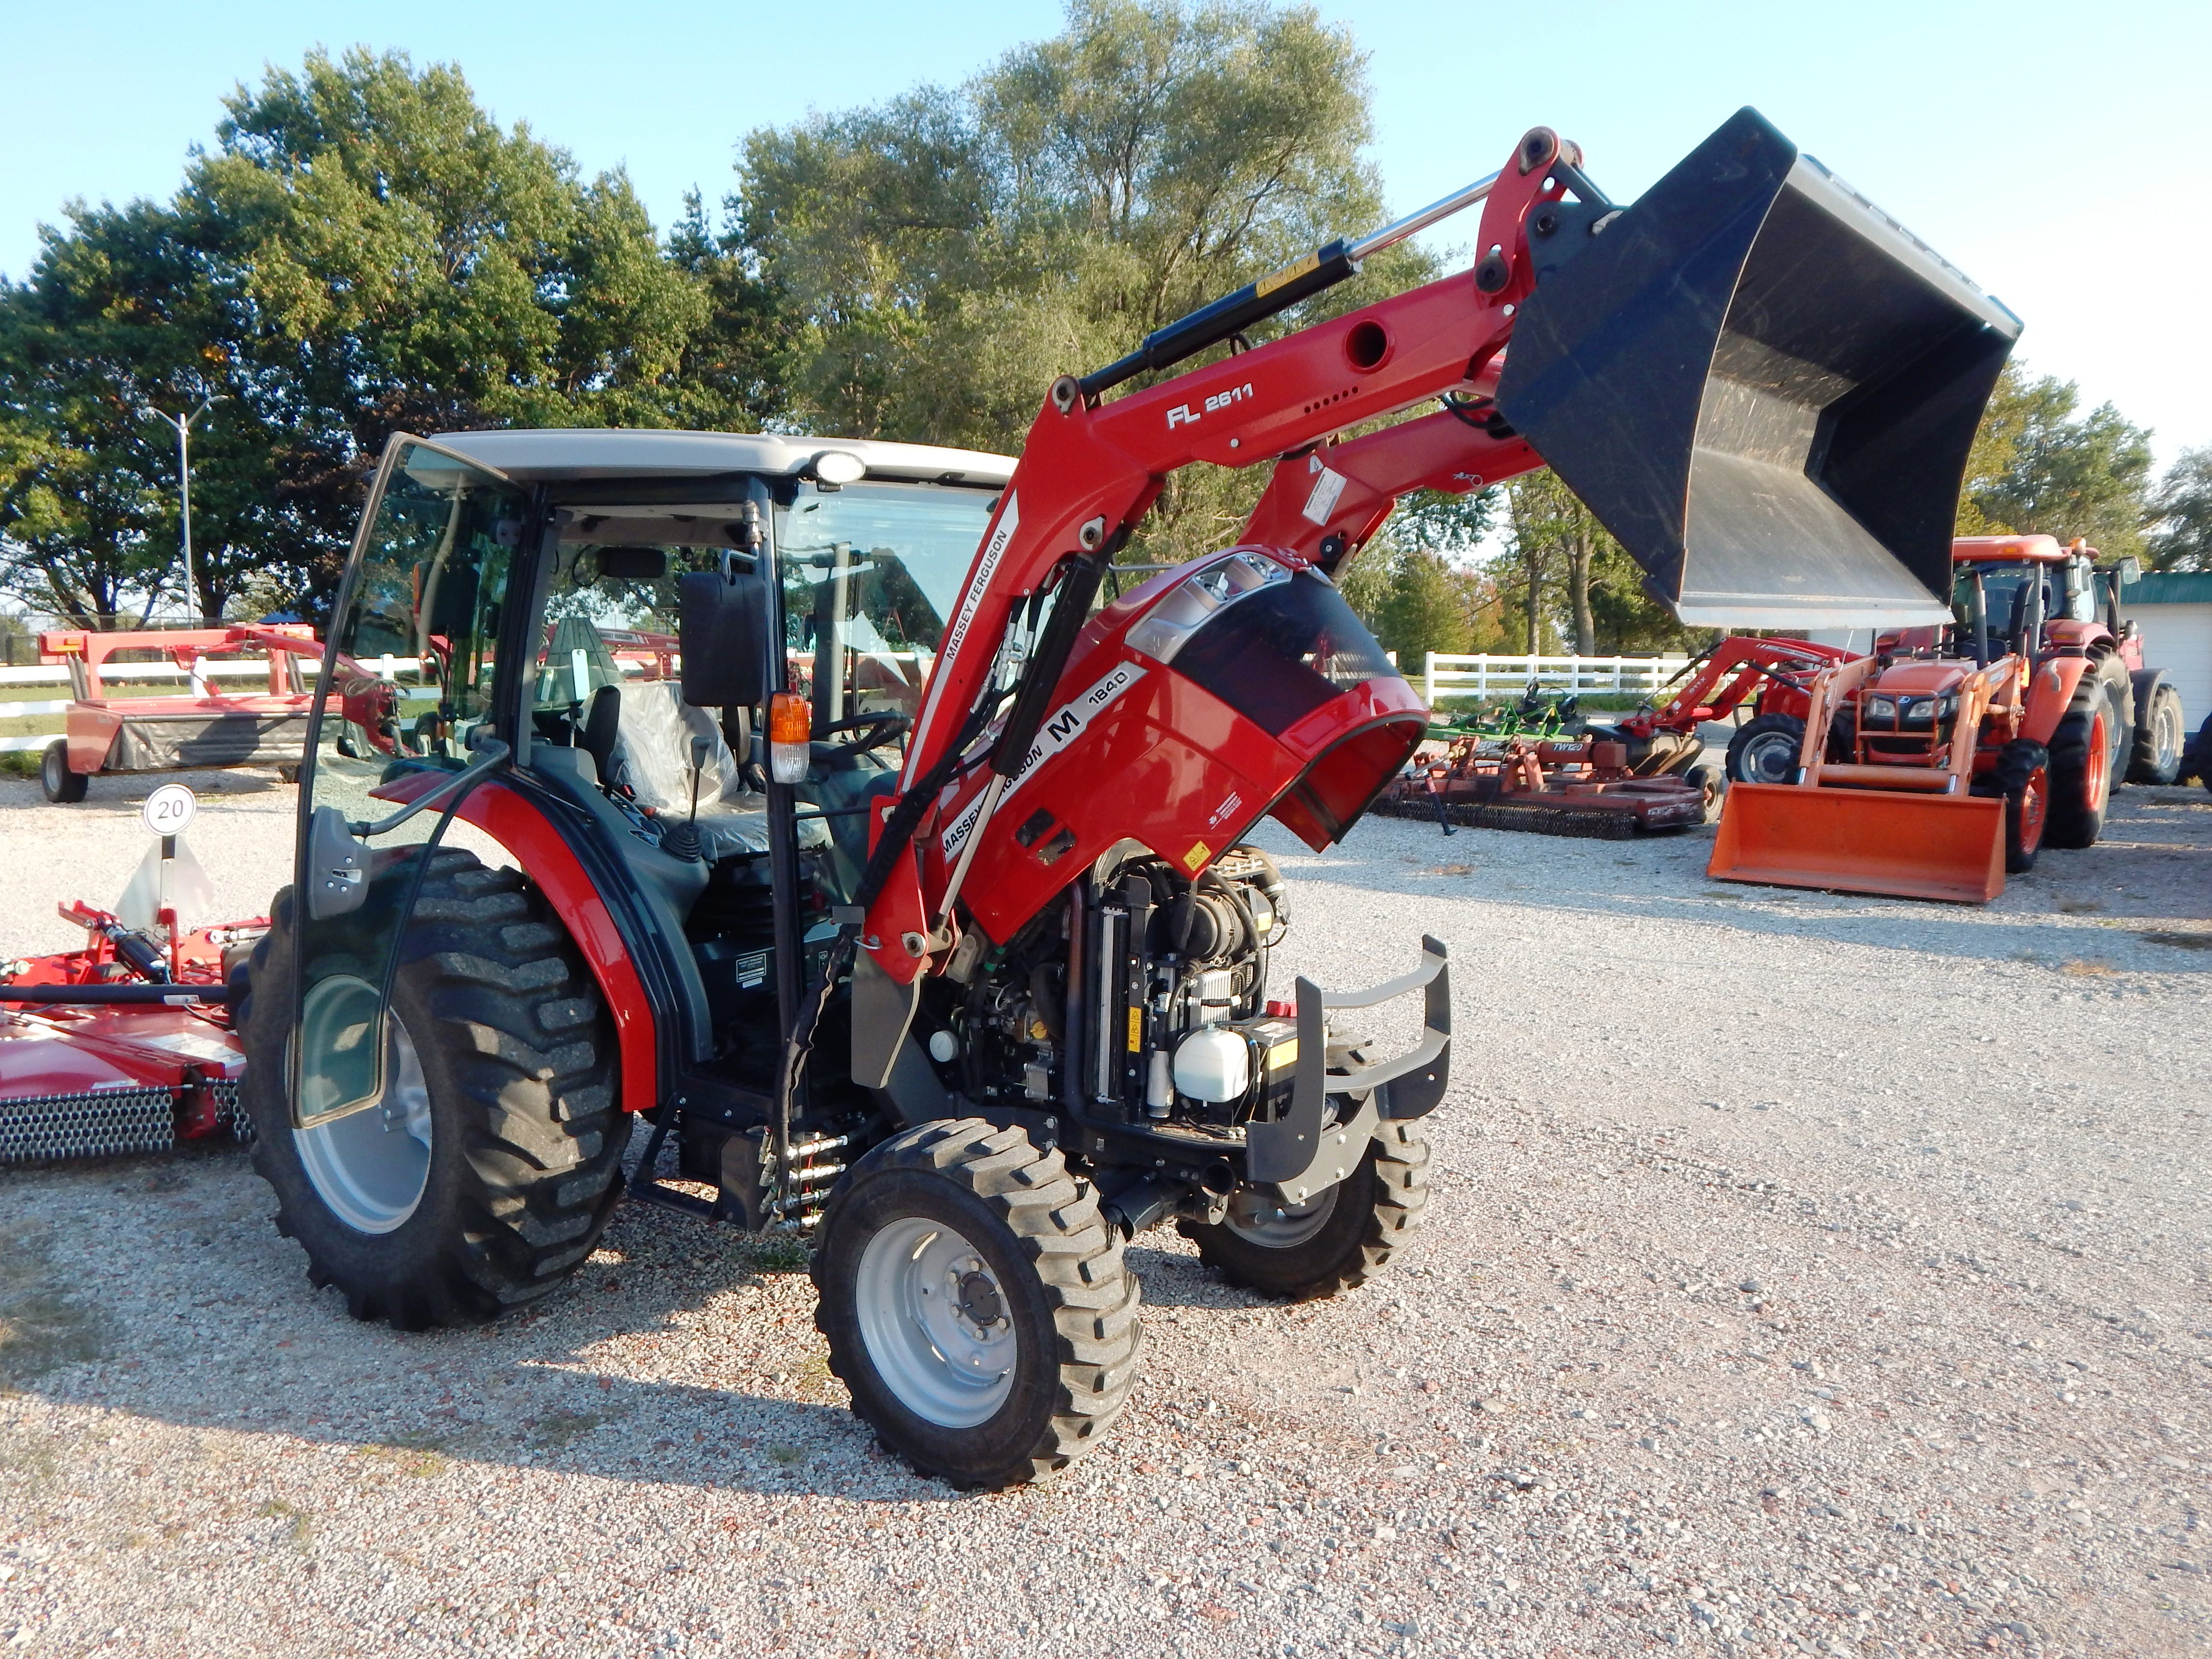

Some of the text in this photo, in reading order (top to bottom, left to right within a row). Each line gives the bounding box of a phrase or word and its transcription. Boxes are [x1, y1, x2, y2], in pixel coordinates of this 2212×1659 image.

[1167, 383, 1254, 429] FL 2611
[946, 529, 1007, 660] MASSEY FERGUSON
[1047, 710, 1080, 743] M
[1088, 672, 1128, 705] 1840
[1554, 743, 1584, 751] TW120
[157, 800, 183, 819] 20
